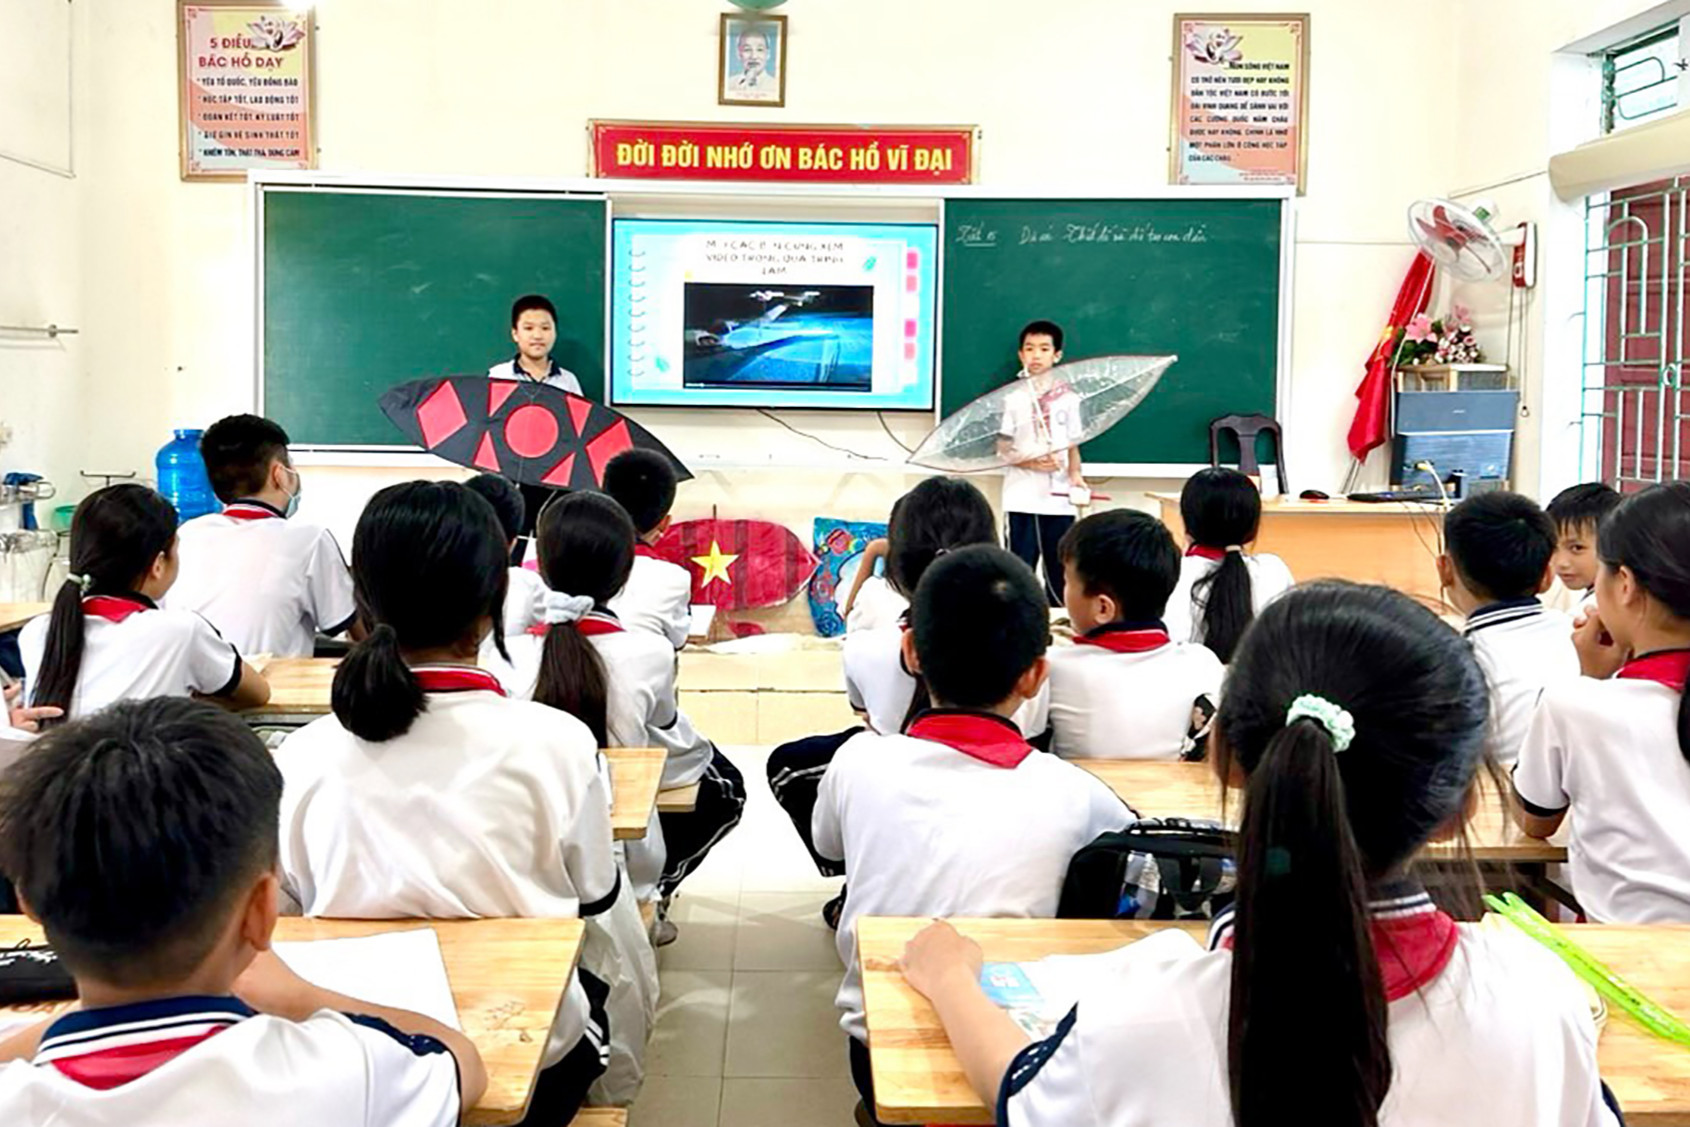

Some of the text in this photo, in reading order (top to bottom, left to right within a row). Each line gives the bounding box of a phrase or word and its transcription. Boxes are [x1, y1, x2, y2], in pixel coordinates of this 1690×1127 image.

[210, 38, 218, 49] 5
[198, 54, 227, 68] BÁC
[255, 57, 284, 72] DẠY
[616, 139, 655, 167] ĐỜI
[661, 140, 699, 168] ĐỜI
[706, 142, 754, 169] NHỚ
[760, 144, 791, 170] ƠN
[798, 143, 844, 170] BÁC
[886, 144, 909, 171] VĨ
[914, 148, 952, 176] ĐẠI
